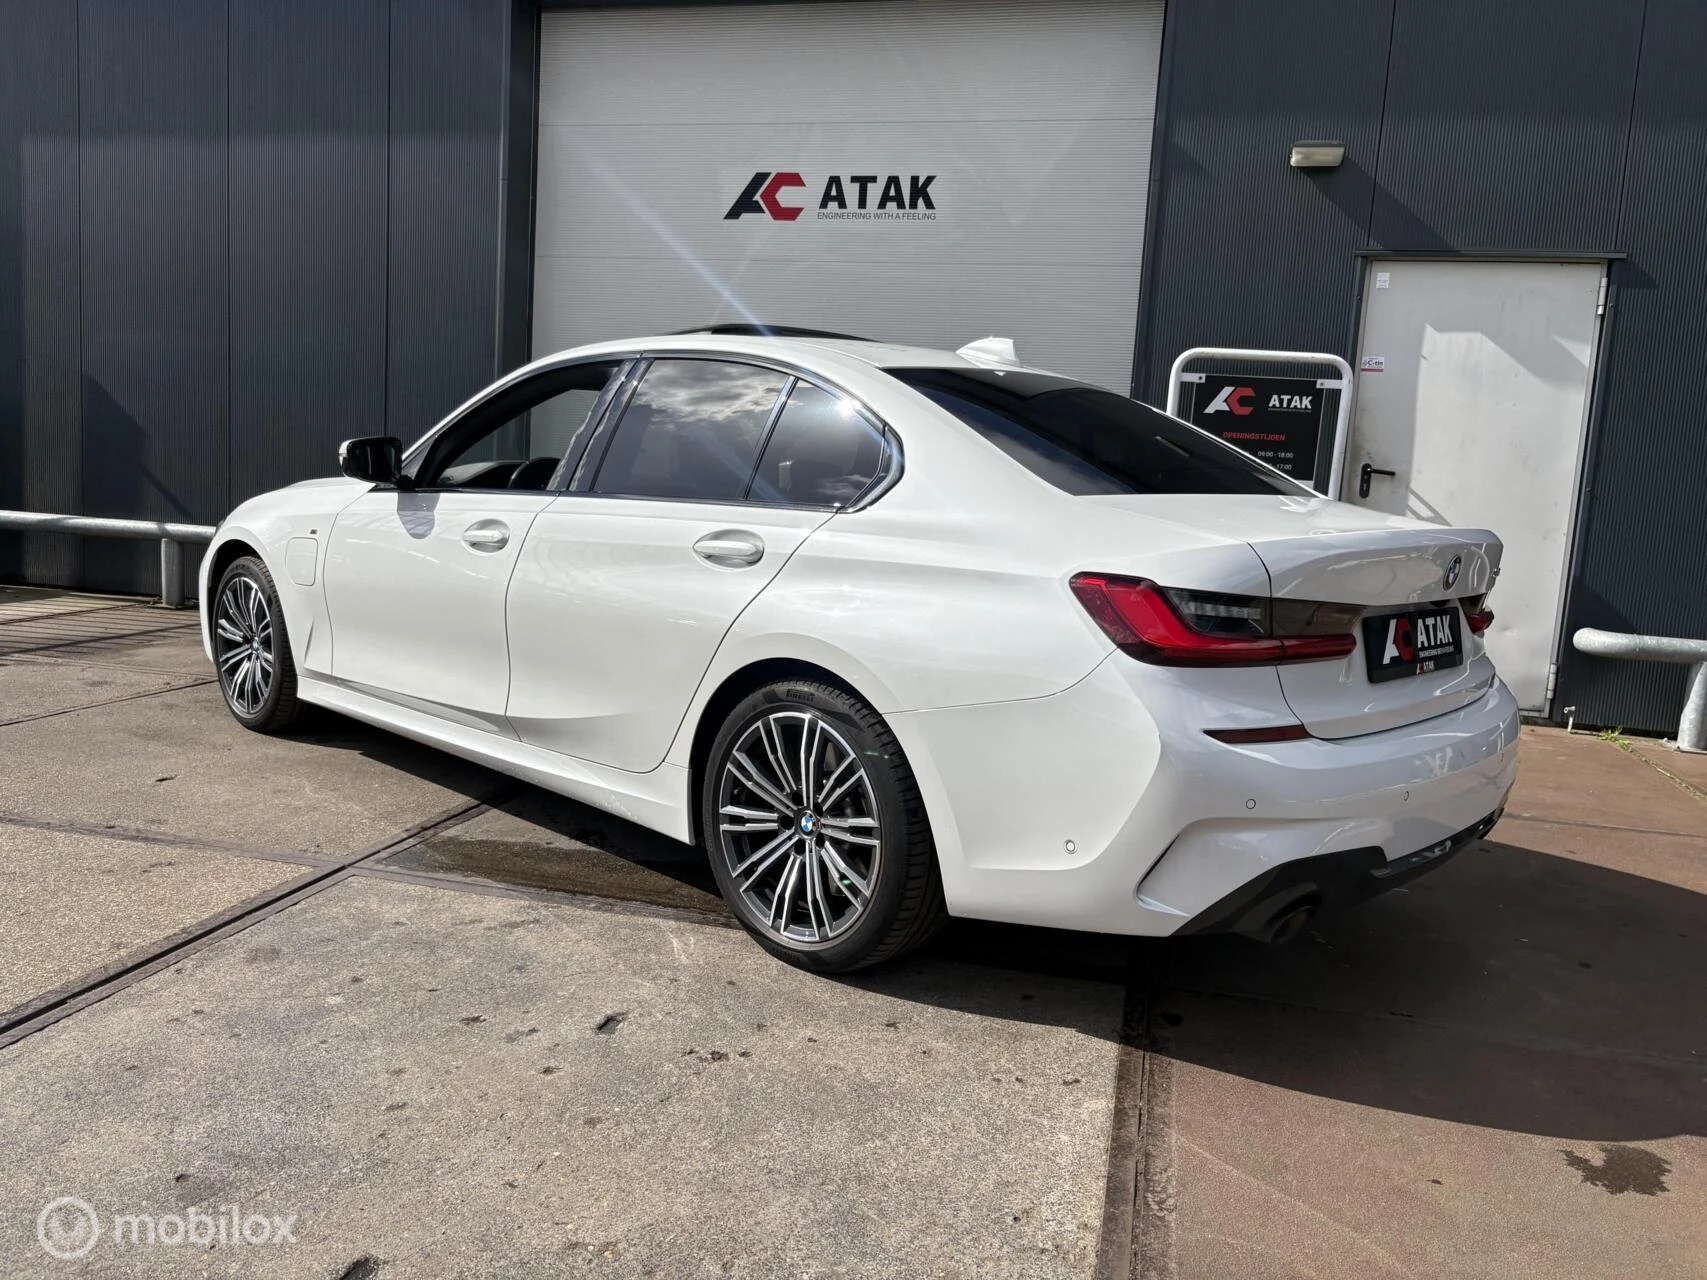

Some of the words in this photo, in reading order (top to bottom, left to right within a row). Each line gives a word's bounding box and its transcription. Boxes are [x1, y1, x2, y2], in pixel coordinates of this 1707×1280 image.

[819, 175, 936, 210] ATAK
[817, 212, 872, 220] ENGINEERING
[873, 212, 894, 220] WITH
[902, 212, 936, 221] FEELING
[1268, 394, 1312, 409] ATAK
[1222, 431, 1286, 441] OPENINGSTIJDEN
[1417, 615, 1453, 648] ATAK
